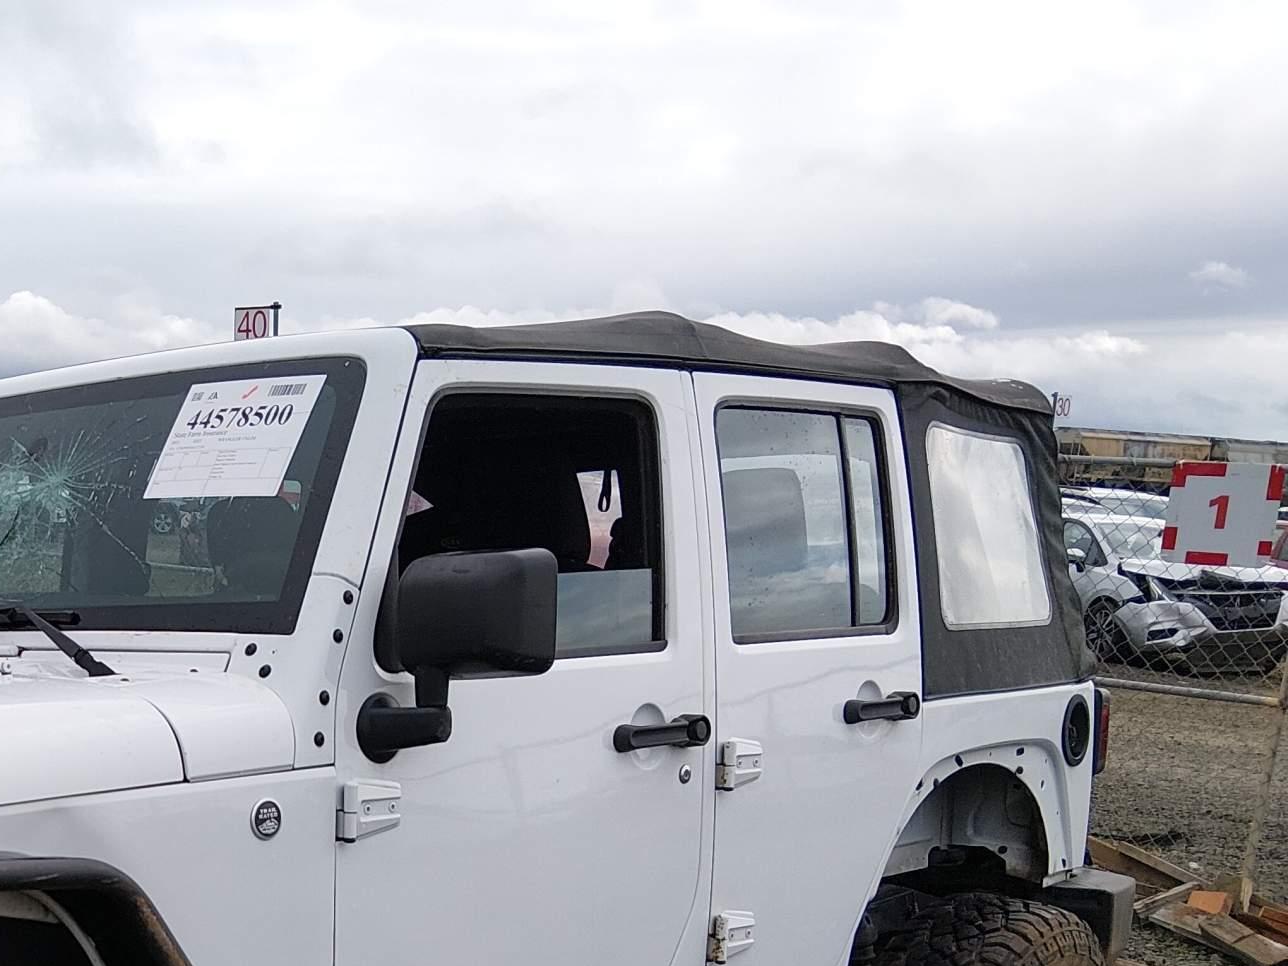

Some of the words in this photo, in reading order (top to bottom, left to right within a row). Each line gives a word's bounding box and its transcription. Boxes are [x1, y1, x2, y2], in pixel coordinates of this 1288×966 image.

[237, 311, 267, 340] 40
[186, 404, 294, 430] 44578500
[1056, 397, 1071, 417] 30
[1209, 495, 1230, 530] 1
